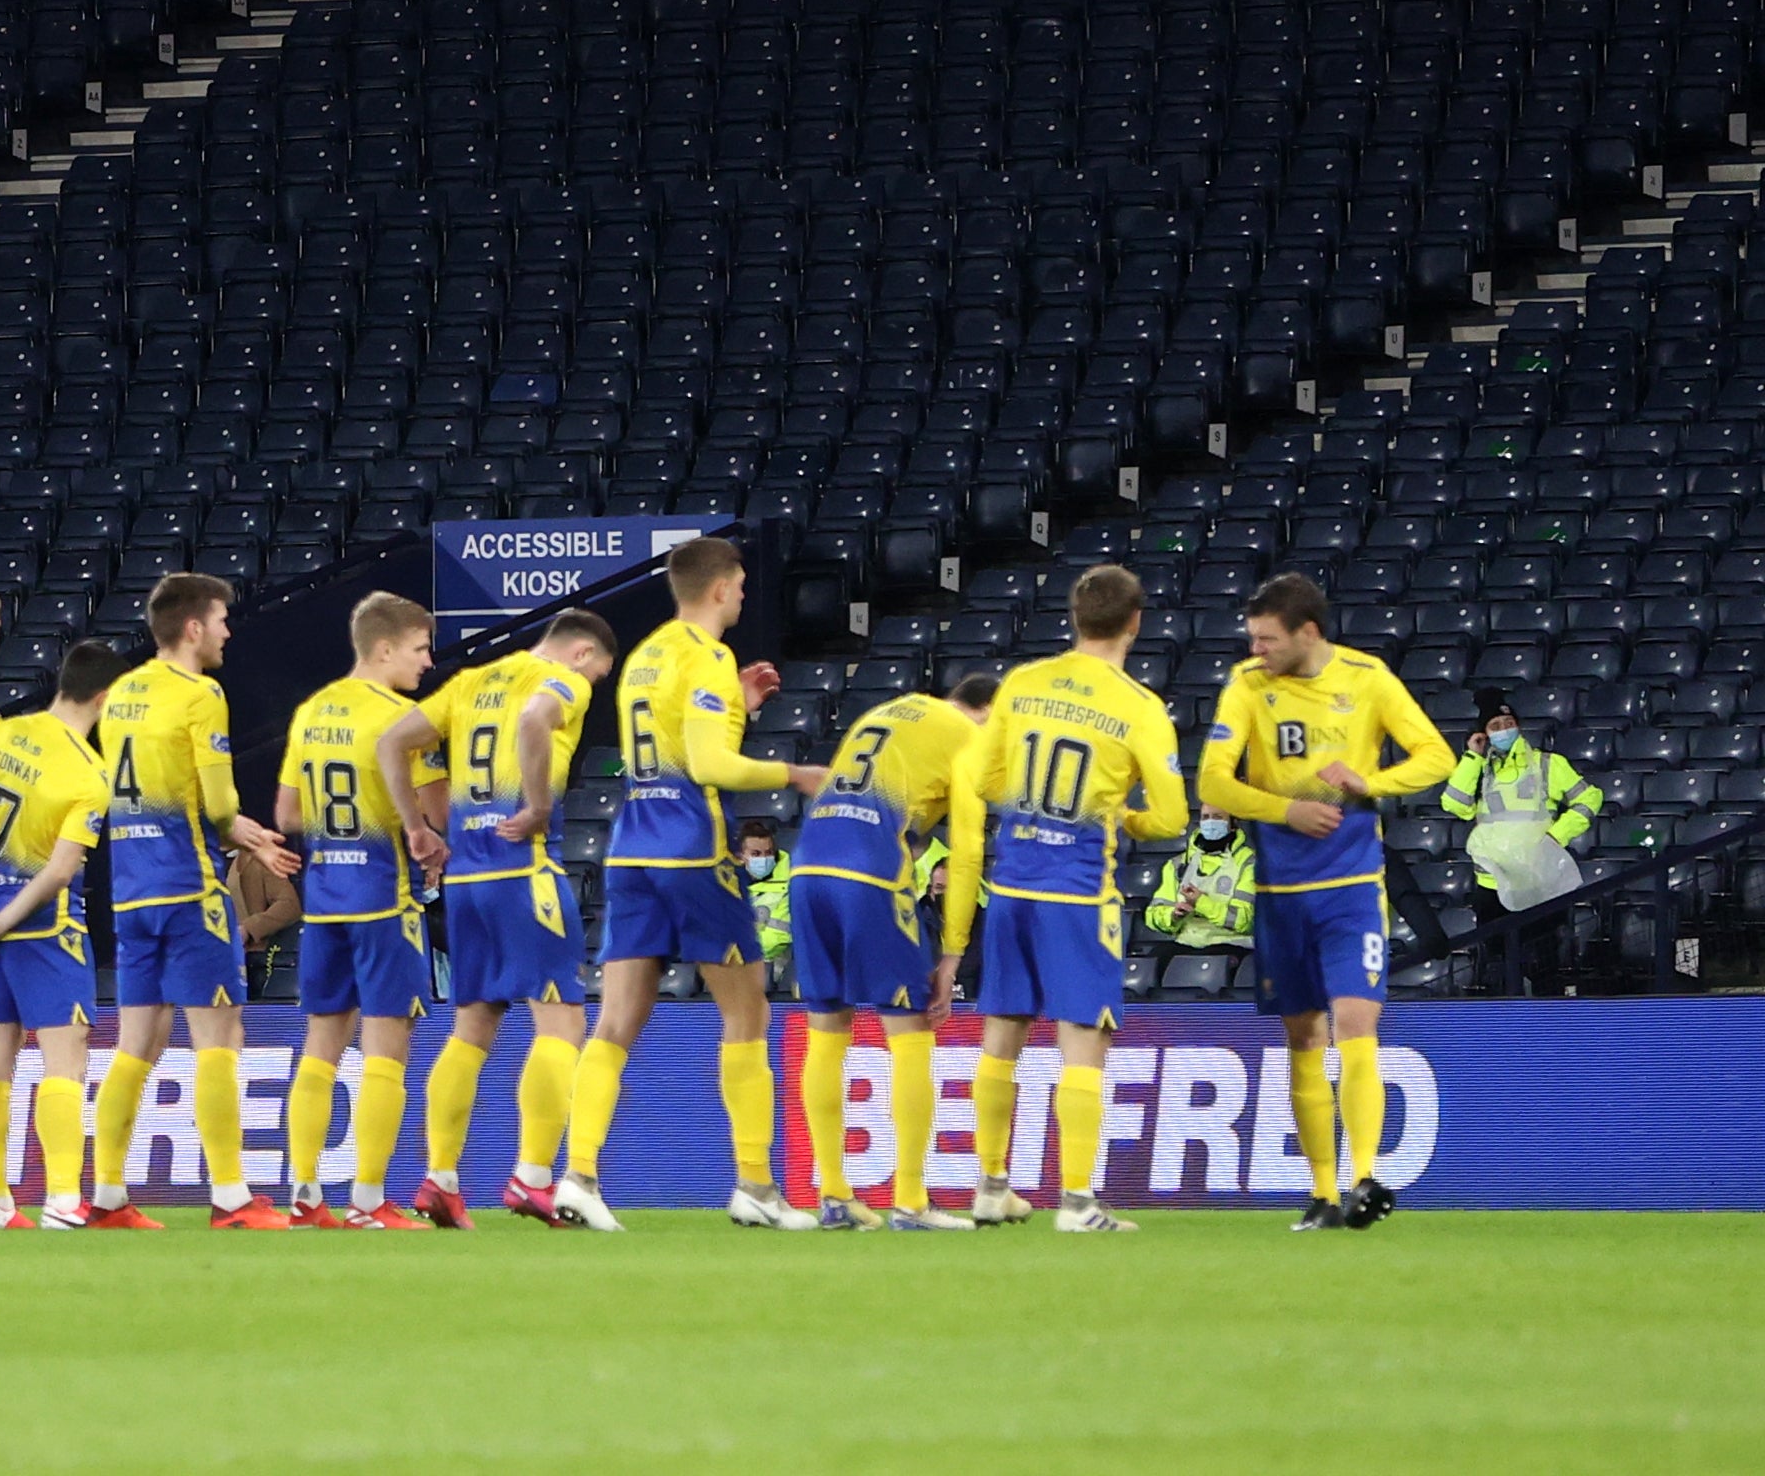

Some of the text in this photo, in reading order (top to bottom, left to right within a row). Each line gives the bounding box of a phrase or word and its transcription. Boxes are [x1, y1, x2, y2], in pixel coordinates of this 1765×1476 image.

[88, 91, 100, 102] AA
[460, 530, 625, 560] ACCESSIBLE
[502, 569, 583, 598] KIOSK
[632, 697, 661, 783] 6
[1012, 696, 1131, 740] WOTHERSPOON
[113, 734, 143, 815] 4
[469, 723, 499, 806] 9
[833, 724, 894, 795] 3
[1017, 730, 1094, 825] 10
[301, 760, 364, 842] 18
[323, 849, 369, 865] TAXIS
[1360, 931, 1386, 973] 8
